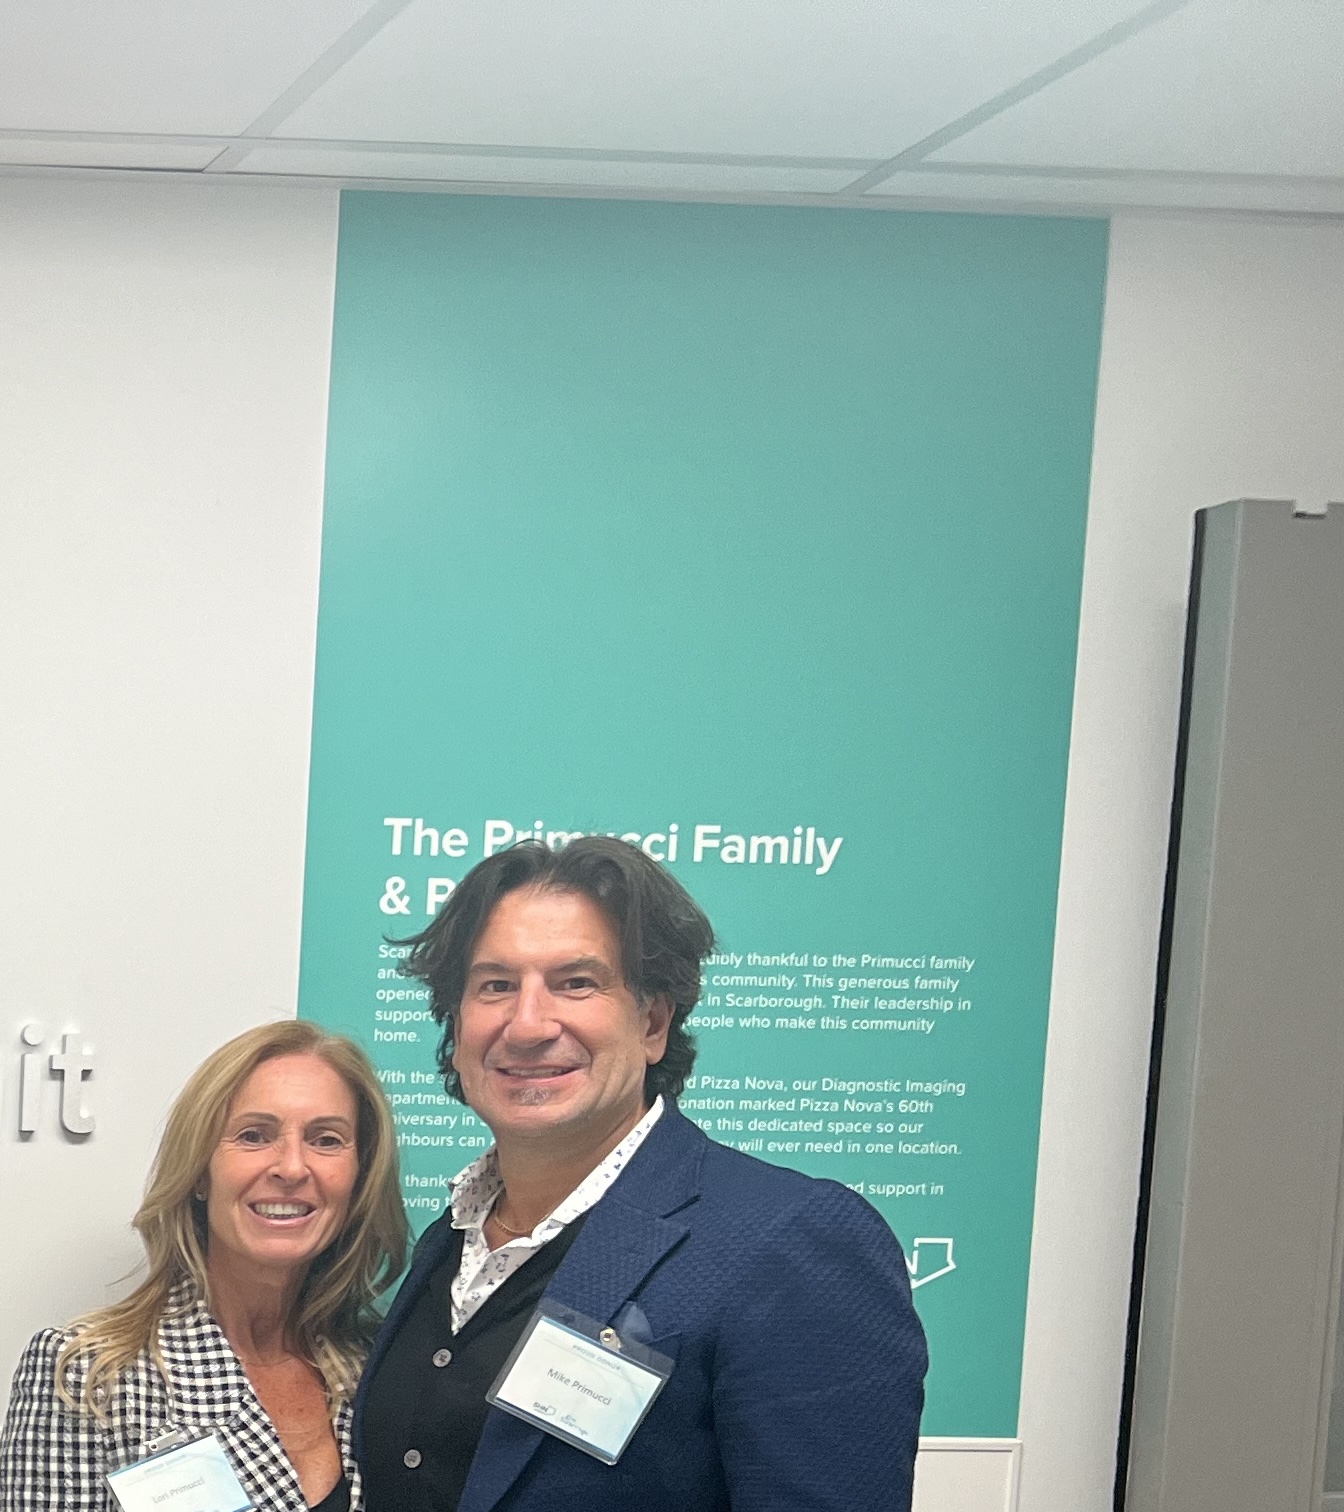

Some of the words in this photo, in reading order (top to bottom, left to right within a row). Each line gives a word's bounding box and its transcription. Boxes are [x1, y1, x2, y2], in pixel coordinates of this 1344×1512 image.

[383, 817, 469, 857] The
[692, 824, 844, 875] Family
[378, 876, 410, 915] &
[747, 952, 809, 967] thankful
[813, 954, 828, 968] to
[832, 953, 857, 968] the
[861, 953, 925, 969] Primucci
[929, 955, 976, 972] family
[712, 974, 797, 990] community.
[803, 973, 834, 988] This
[838, 976, 910, 992] generous
[914, 975, 960, 993] family
[725, 993, 826, 1011] Scarborough.
[832, 994, 869, 1010] Their
[874, 995, 953, 1013] leadership
[958, 997, 972, 1011] in
[739, 1014, 770, 1028] who
[775, 1015, 816, 1029] make
[820, 1015, 847, 1030] this
[851, 1016, 935, 1034] community
[373, 1028, 420, 1042] home.
[410, 1070, 435, 1084] the
[700, 1075, 740, 1090] Pizza
[744, 1076, 787, 1092] Nova,
[792, 1079, 817, 1091] our
[821, 1077, 902, 1095] Diagnostic
[905, 1079, 967, 1096] Imaging
[678, 1097, 735, 1111] onation
[739, 1097, 795, 1112] marked
[800, 1099, 839, 1112] Pizza
[843, 1099, 894, 1113] Nova's
[898, 1099, 934, 1113] 60th
[462, 1113, 476, 1126] in
[716, 1117, 743, 1132] this
[747, 1118, 823, 1133] dedicated
[827, 1120, 872, 1135] space
[876, 1121, 894, 1134] so
[898, 1122, 924, 1134] our
[458, 1135, 485, 1147] can
[737, 1138, 764, 1152] will
[767, 1141, 800, 1153] ever
[804, 1140, 843, 1154] need
[847, 1140, 861, 1153] in
[864, 1142, 894, 1154] one
[898, 1140, 962, 1156] location.
[868, 1181, 926, 1197] support
[930, 1180, 944, 1195] in
[547, 1367, 571, 1386] Mike
[571, 1379, 613, 1406] Primucci
[152, 1492, 170, 1504] Lori
